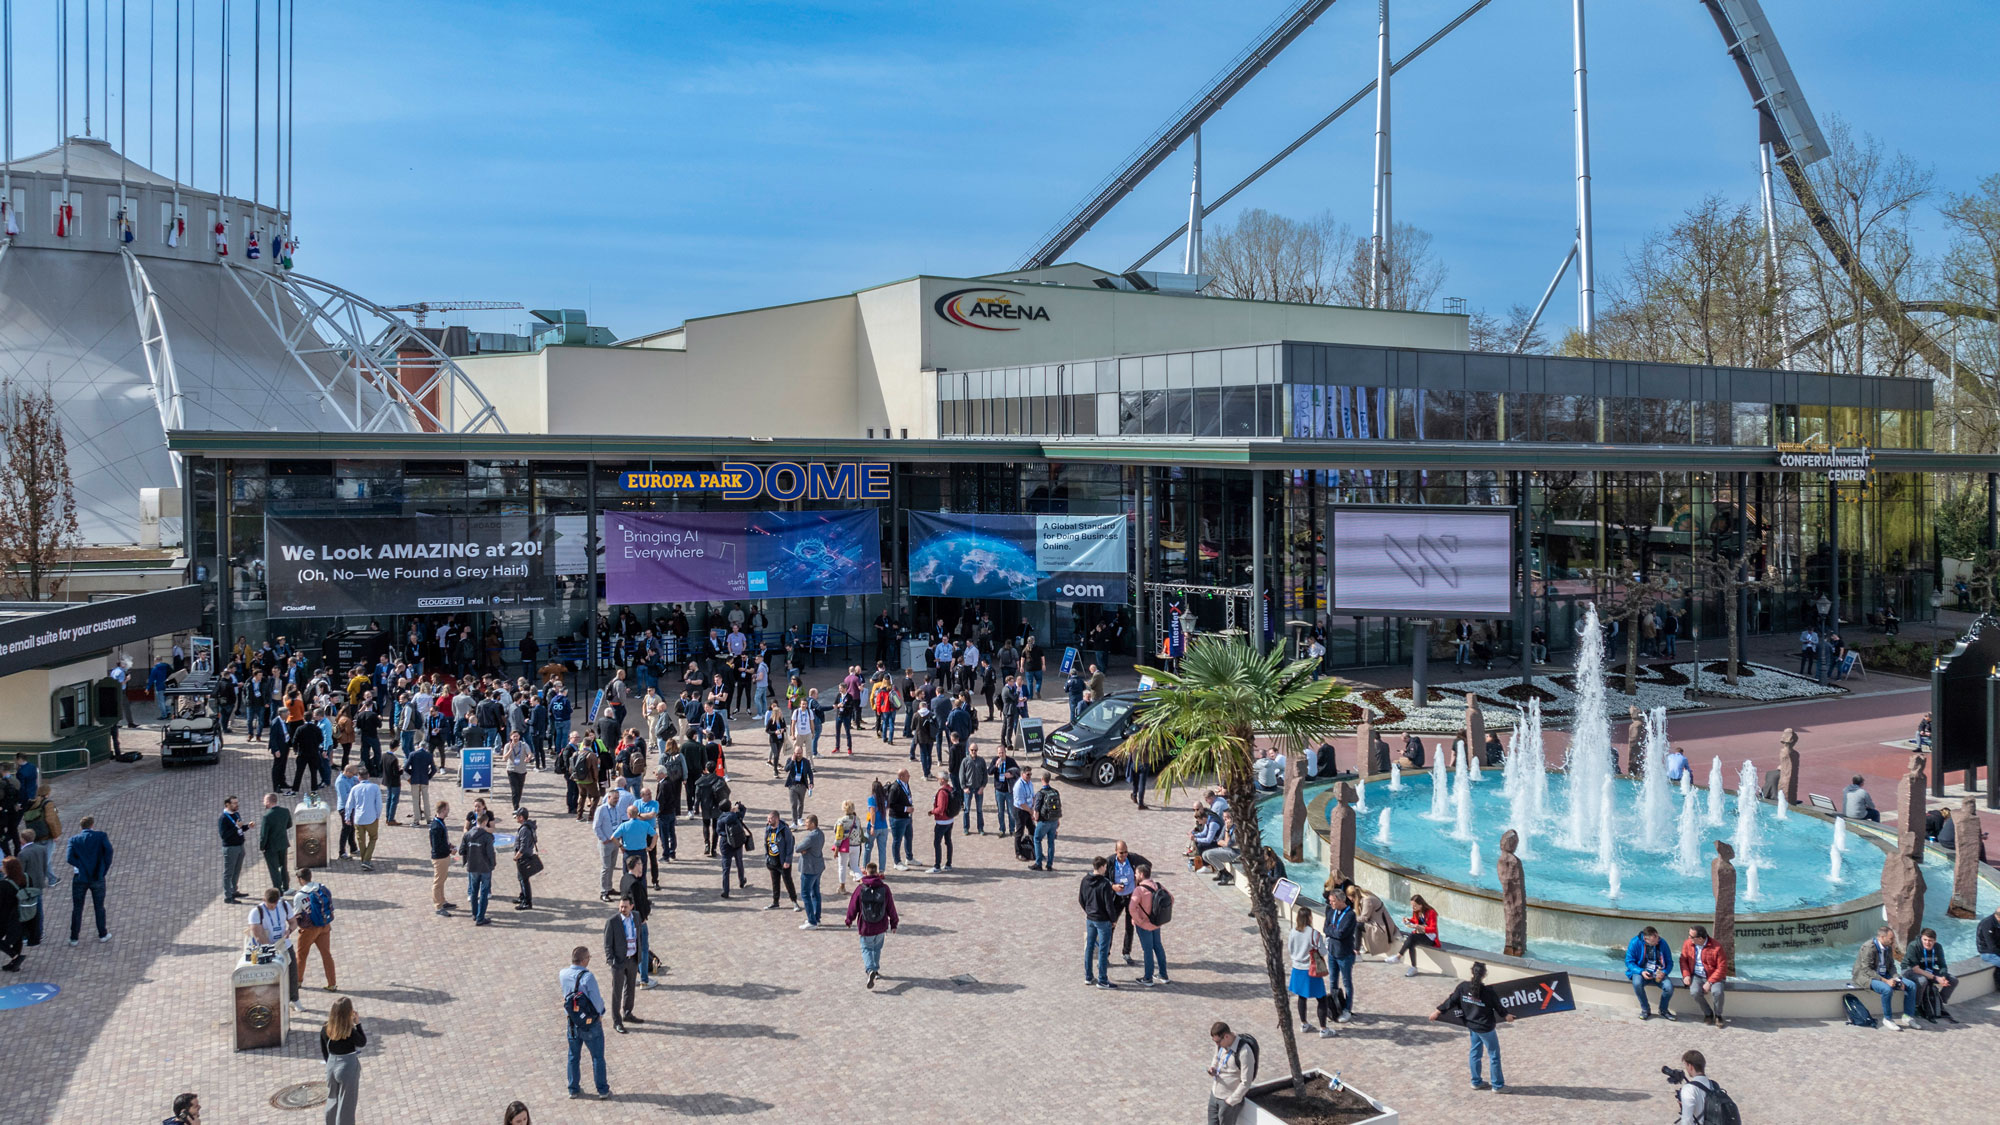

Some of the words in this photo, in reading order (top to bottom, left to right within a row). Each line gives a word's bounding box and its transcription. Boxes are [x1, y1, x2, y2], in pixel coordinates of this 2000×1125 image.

[969, 302, 1051, 321] ARENA
[1780, 454, 1870, 467] CONFERTAINMENT
[627, 473, 695, 488] EUROPA
[700, 473, 743, 488] PARK
[722, 461, 891, 501] DOME
[1828, 469, 1866, 481] CENTER
[1078, 522, 1116, 530] Standard
[624, 530, 681, 546] Bringing
[684, 530, 699, 543] AI
[1056, 533, 1080, 541] Doing
[1081, 532, 1118, 540] Business
[282, 545, 315, 561] We
[321, 544, 373, 561] Look
[378, 543, 480, 559] AMAZING
[485, 543, 506, 557] at
[510, 541, 543, 556] 20!
[624, 546, 704, 561] Everywhere
[297, 568, 329, 583] (Oh,
[394, 565, 439, 579] Found
[443, 569, 452, 578] a
[455, 565, 489, 580] Grey
[492, 564, 529, 578] Hair!)
[1056, 584, 1104, 597] .com
[419, 598, 463, 606] CLOUDFEST
[9, 635, 35, 653] email
[36, 631, 58, 647] suite
[59, 627, 72, 640] for
[72, 624, 93, 642] your
[93, 615, 136, 631] customers
[1735, 927, 1775, 937] runnen
[1777, 924, 1794, 935] der
[1797, 919, 1849, 936] Begegnung
[1500, 980, 1564, 1010] erNetX
